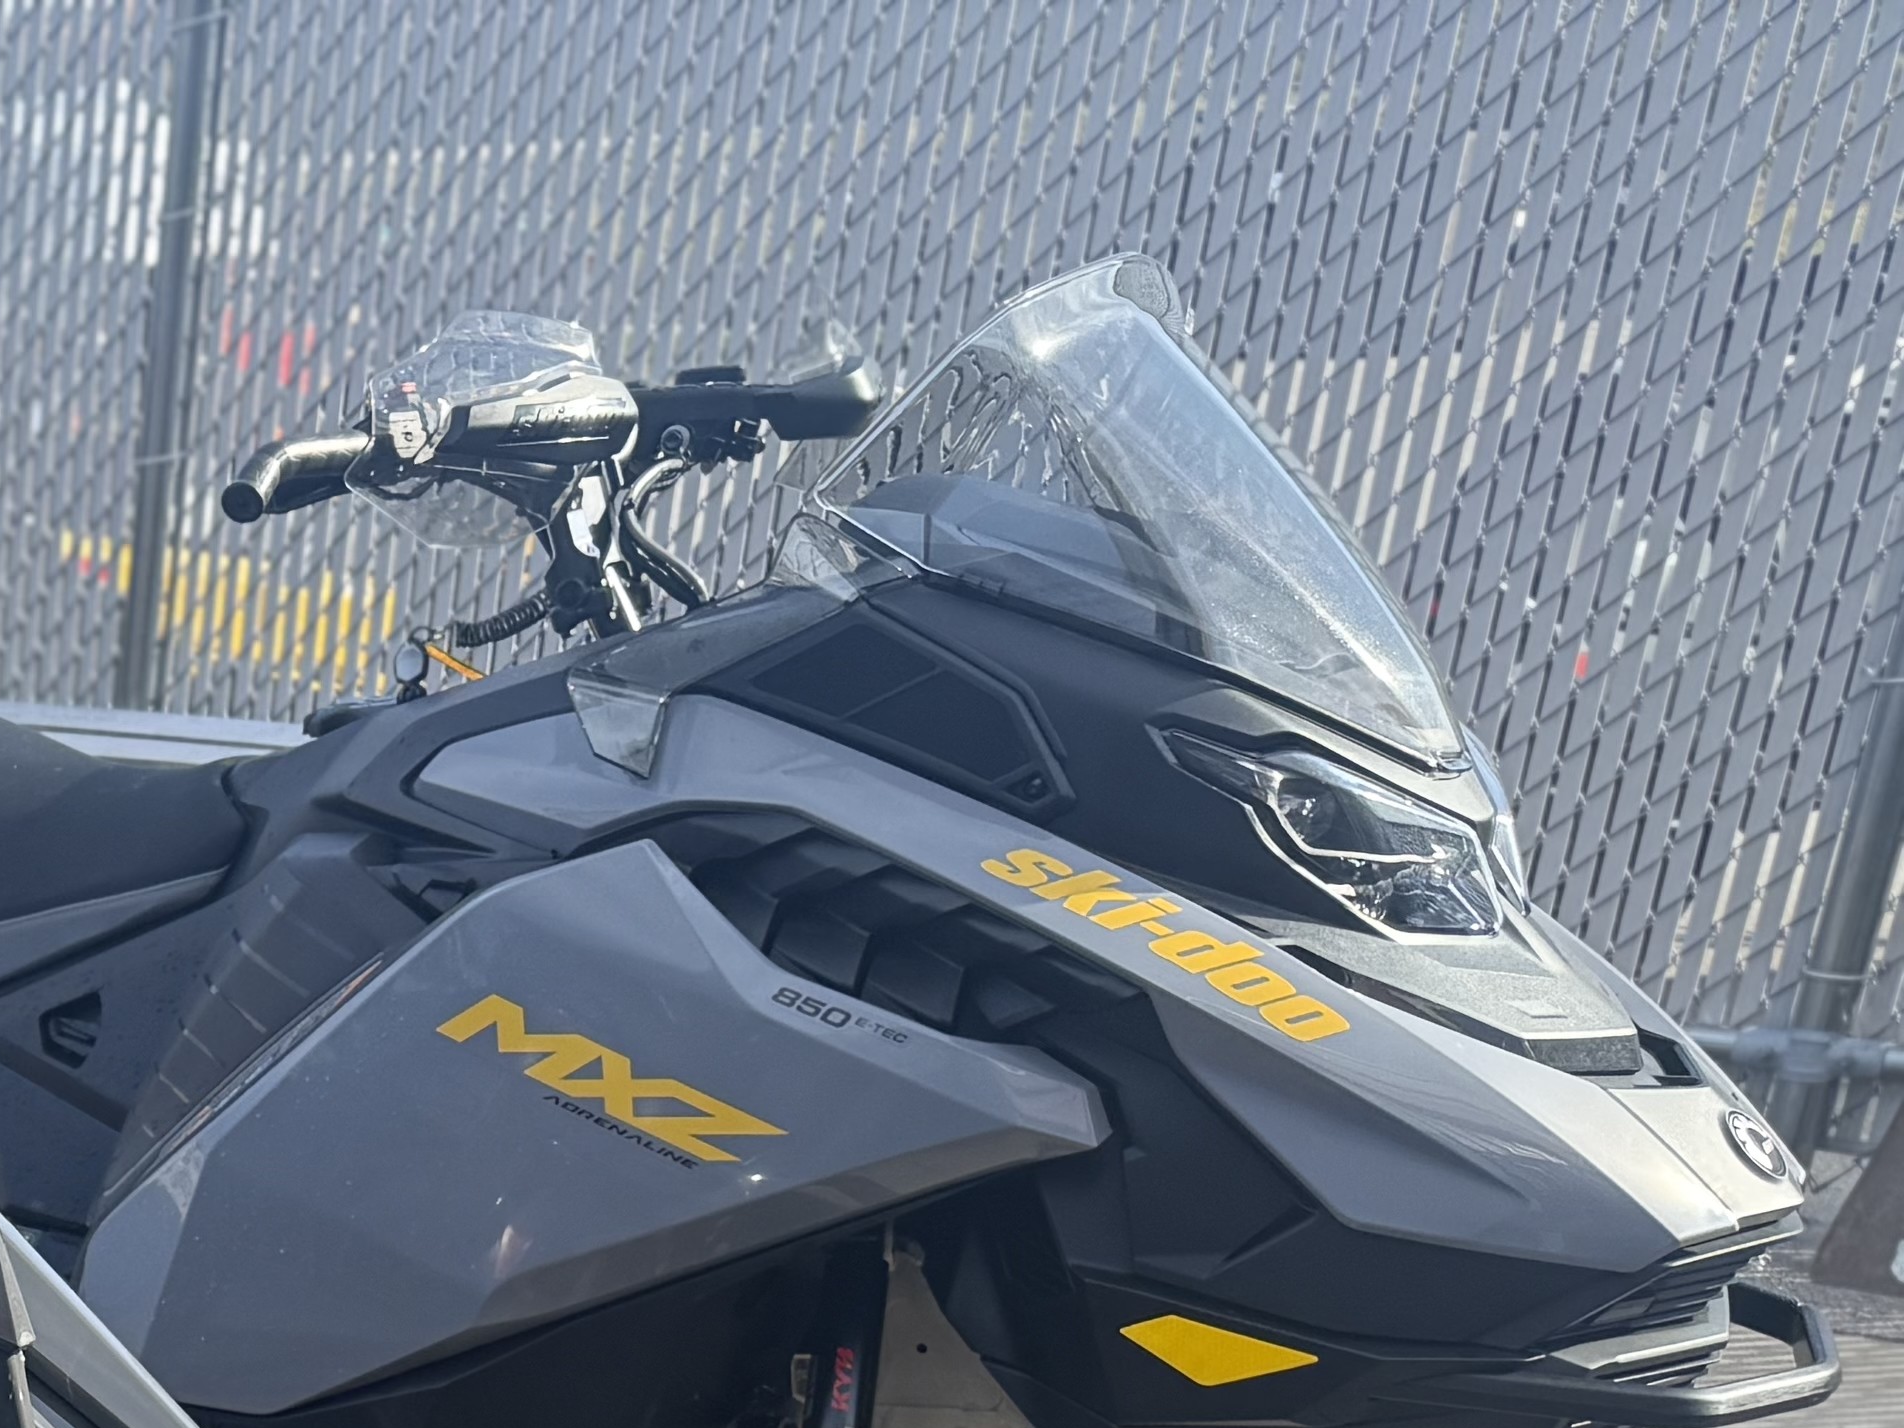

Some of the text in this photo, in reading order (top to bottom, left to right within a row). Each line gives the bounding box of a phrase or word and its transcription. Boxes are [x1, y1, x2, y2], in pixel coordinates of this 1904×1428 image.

[771, 986, 908, 1044] 850 E-TEC
[435, 993, 790, 1162] MXZ
[542, 1095, 699, 1170] ADRENALINE
